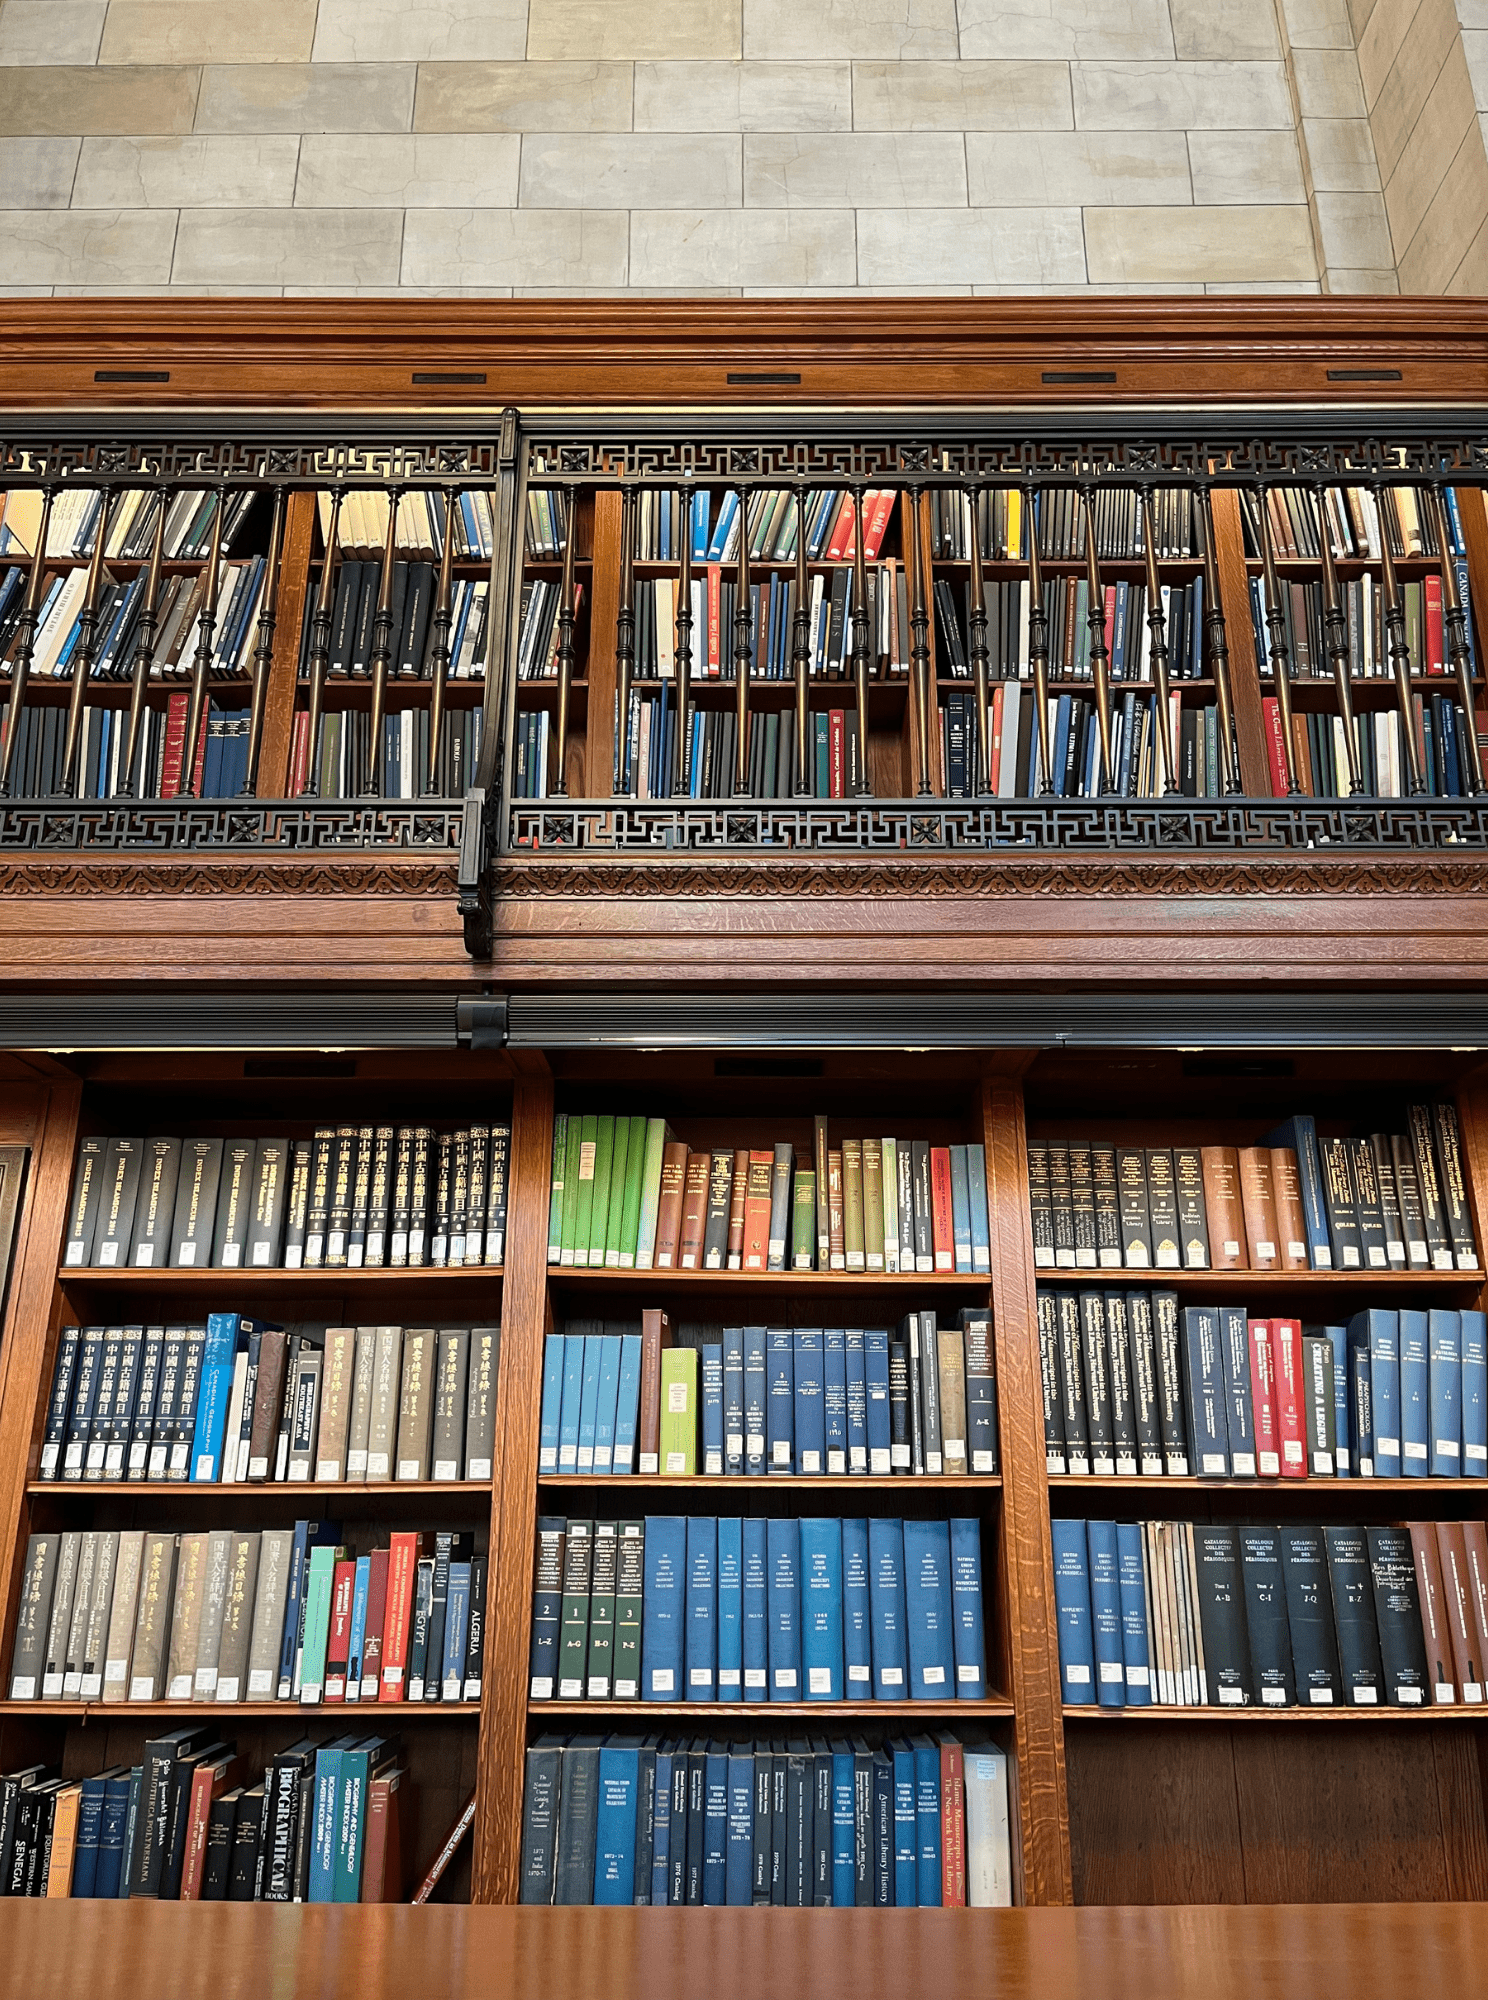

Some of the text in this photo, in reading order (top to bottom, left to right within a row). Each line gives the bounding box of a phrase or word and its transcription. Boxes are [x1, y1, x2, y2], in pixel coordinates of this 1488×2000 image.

[1459, 572, 1468, 606] CANADA
[832, 598, 842, 637] PARIS
[84, 1158, 93, 1181] INDEX
[154, 1158, 162, 1181] INDEX
[194, 1158, 203, 1182] INDEX
[232, 1164, 242, 1188] INDEX
[1322, 1344, 1330, 1364] Moran
[298, 1384, 306, 1422] SOUTHEAST
[1312, 1342, 1326, 1448] CREATING A LEGEND
[204, 1368, 220, 1453] CANADIAN GEOGRAPHY
[302, 1382, 314, 1442] BIBLIOGRAPHY OF
[50, 1432, 56, 1440] 2
[72, 1432, 78, 1440] 3
[96, 1432, 102, 1440] 4
[114, 1432, 120, 1440] 5
[138, 1432, 144, 1440] 6
[178, 1432, 184, 1440] 8
[1073, 1430, 1080, 1438] 4
[1122, 1430, 1128, 1439] 6
[1172, 1430, 1178, 1438] 8
[544, 1606, 550, 1614] 2
[574, 1608, 578, 1616] 1
[600, 1608, 606, 1617] 2
[626, 1610, 632, 1618] 3
[416, 1610, 426, 1646] EGYPT
[470, 1610, 480, 1656] ALGERIA
[326, 1776, 336, 1814] BIOGRAPHY
[352, 1778, 360, 1816] BIOGRAPHY
[954, 1778, 962, 1806] Islamic
[318, 1803, 326, 1823] INDEX
[270, 1768, 293, 1892] BIOGRAPHICAL
[954, 1808, 962, 1859] Manuscripts
[42, 1834, 52, 1880] EQUATORIAL
[141, 1820, 154, 1882] POLYNESIANA
[323, 1830, 332, 1870] GENEALOGY
[347, 1832, 356, 1873] GENEALOGY
[878, 1794, 889, 1902] American Library History
[946, 1838, 954, 1862] Public
[12, 1840, 26, 1890] SENEGAL
[946, 1866, 954, 1896] Library
